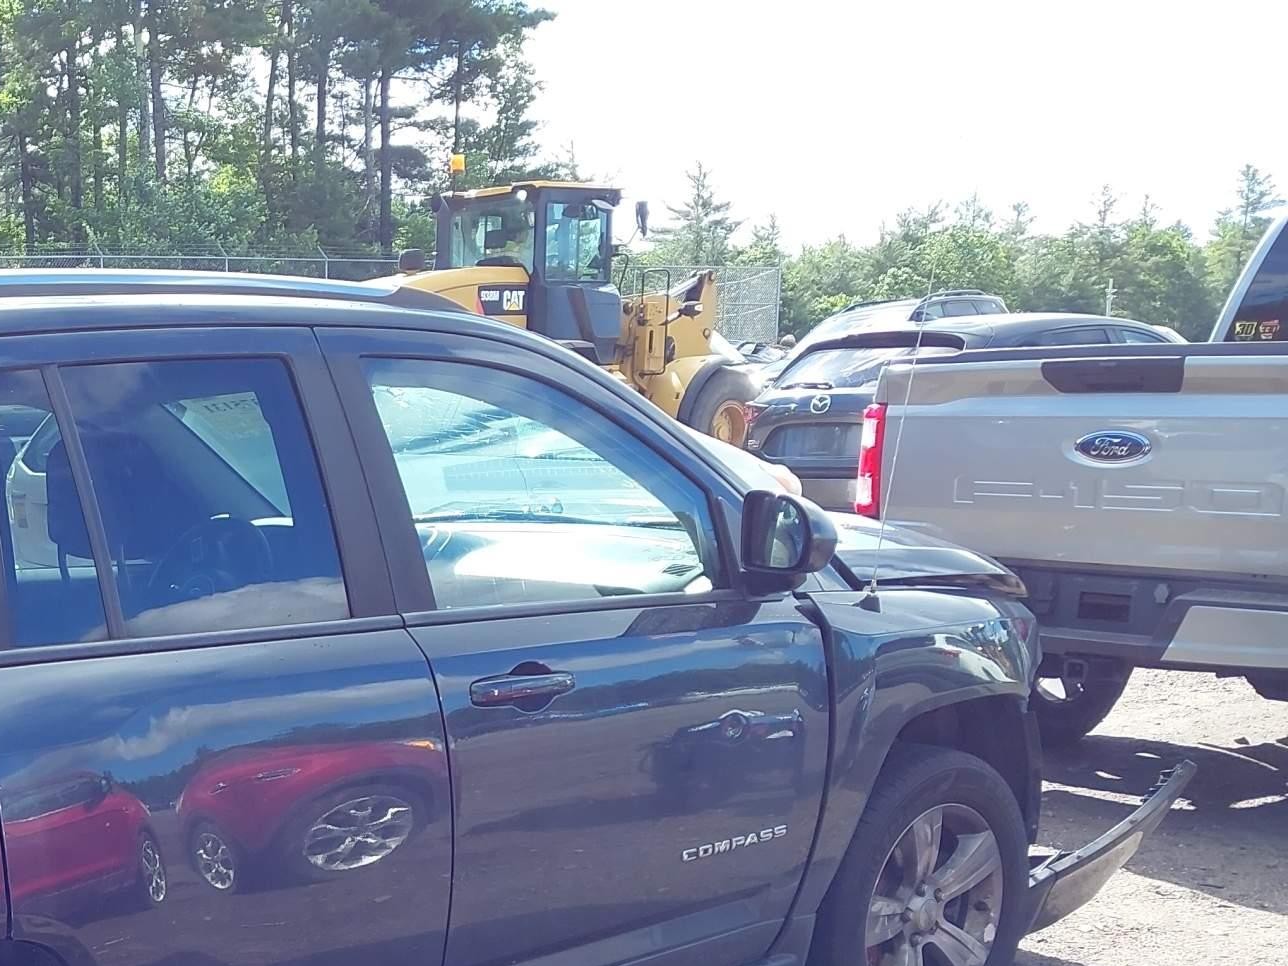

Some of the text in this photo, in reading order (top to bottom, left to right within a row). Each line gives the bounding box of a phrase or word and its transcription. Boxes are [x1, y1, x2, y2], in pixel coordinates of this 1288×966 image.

[503, 290, 525, 310] CAT
[1090, 437, 1132, 456] Ford
[682, 824, 788, 862] COMPASS
